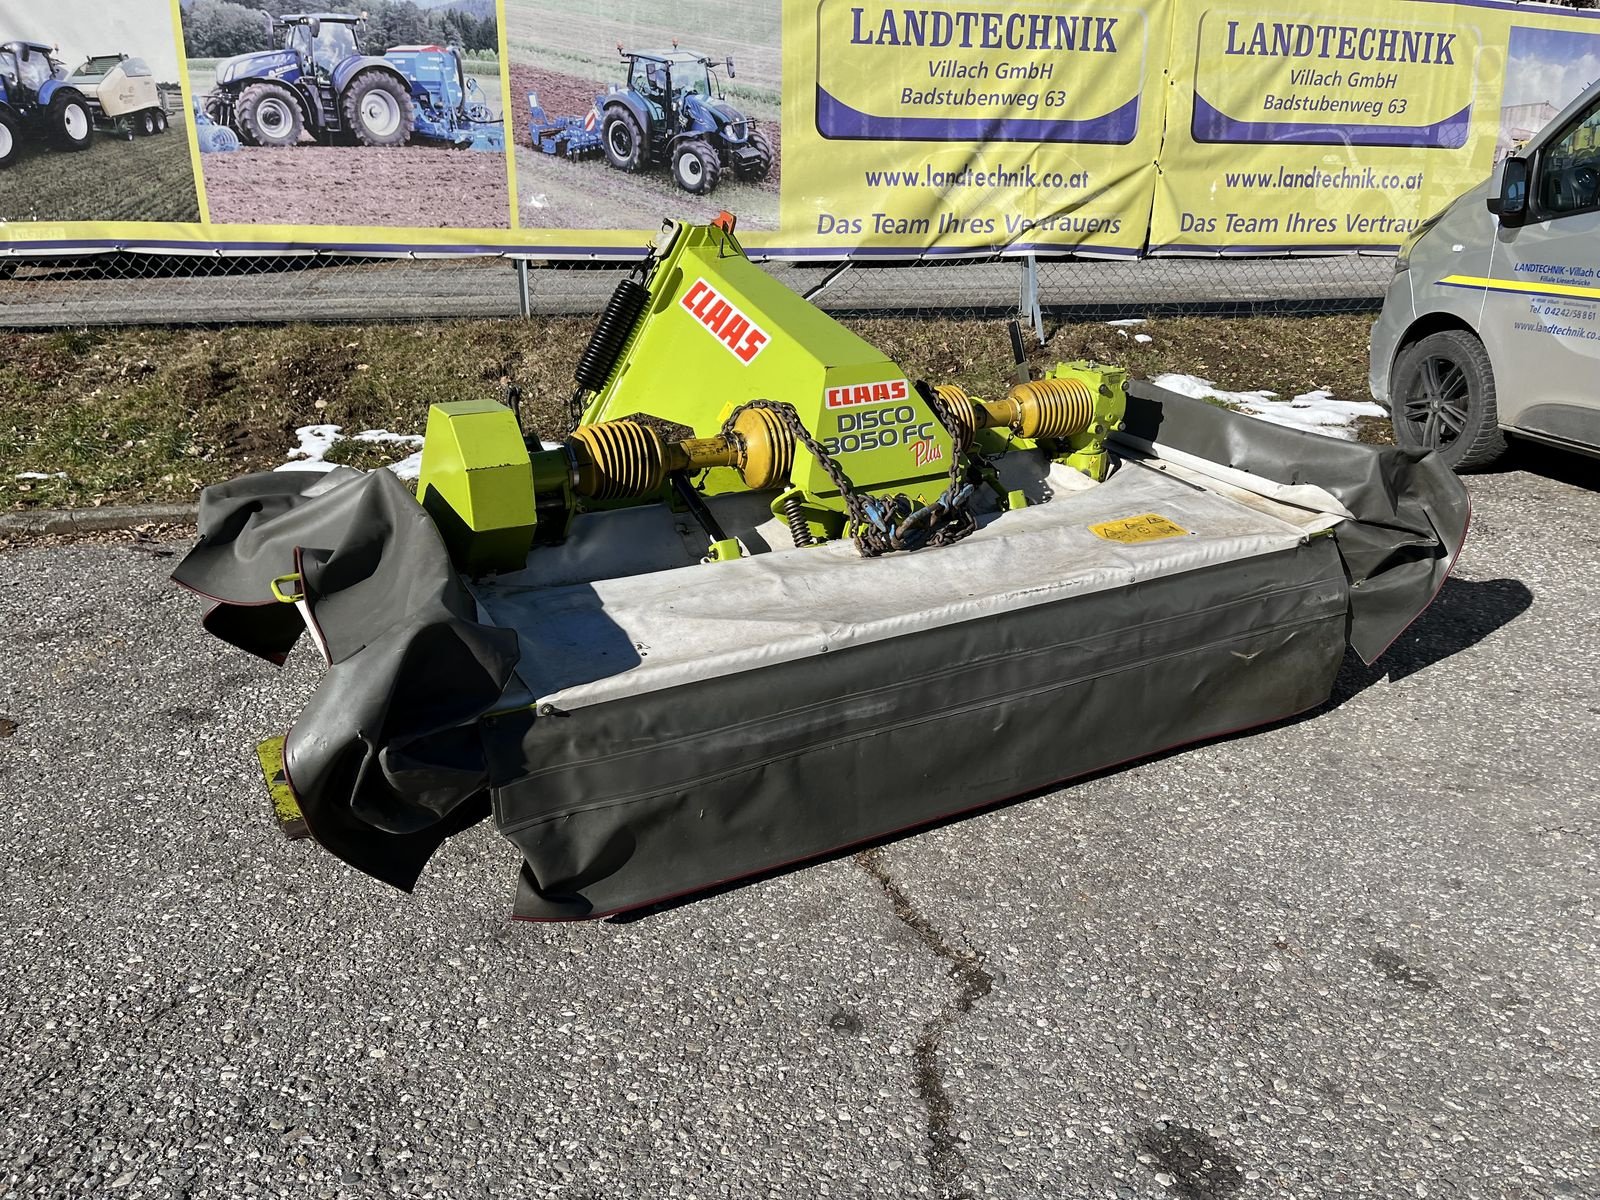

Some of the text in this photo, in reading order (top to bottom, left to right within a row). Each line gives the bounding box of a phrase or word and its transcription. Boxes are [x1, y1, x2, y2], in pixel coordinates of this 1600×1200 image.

[850, 8, 1118, 53] LANDTECHNIK
[1225, 21, 1457, 65] LANDTECHNIK
[928, 60, 1054, 81] Villach GmbH
[1289, 69, 1398, 90] Villach GmbH
[900, 87, 1066, 110] Badstubenweg 63
[1263, 94, 1407, 117] Badstubenweg 63
[865, 164, 1089, 189] www.landtechnik.co.at
[1225, 166, 1423, 190] www.landtechnik.co.at
[817, 213, 862, 234] Das
[870, 213, 930, 234] Team
[938, 212, 995, 235] Ihres
[1180, 212, 1217, 233] Das
[1225, 212, 1279, 233] Team
[1286, 212, 1338, 233] Ihres
[682, 281, 766, 362] CLAAS
[1529, 305, 1541, 314] Tel.
[828, 381, 906, 407] CLAAS
[837, 405, 915, 433] DISCO
[823, 421, 935, 457] 3050 FC
[908, 437, 942, 467] Plus
